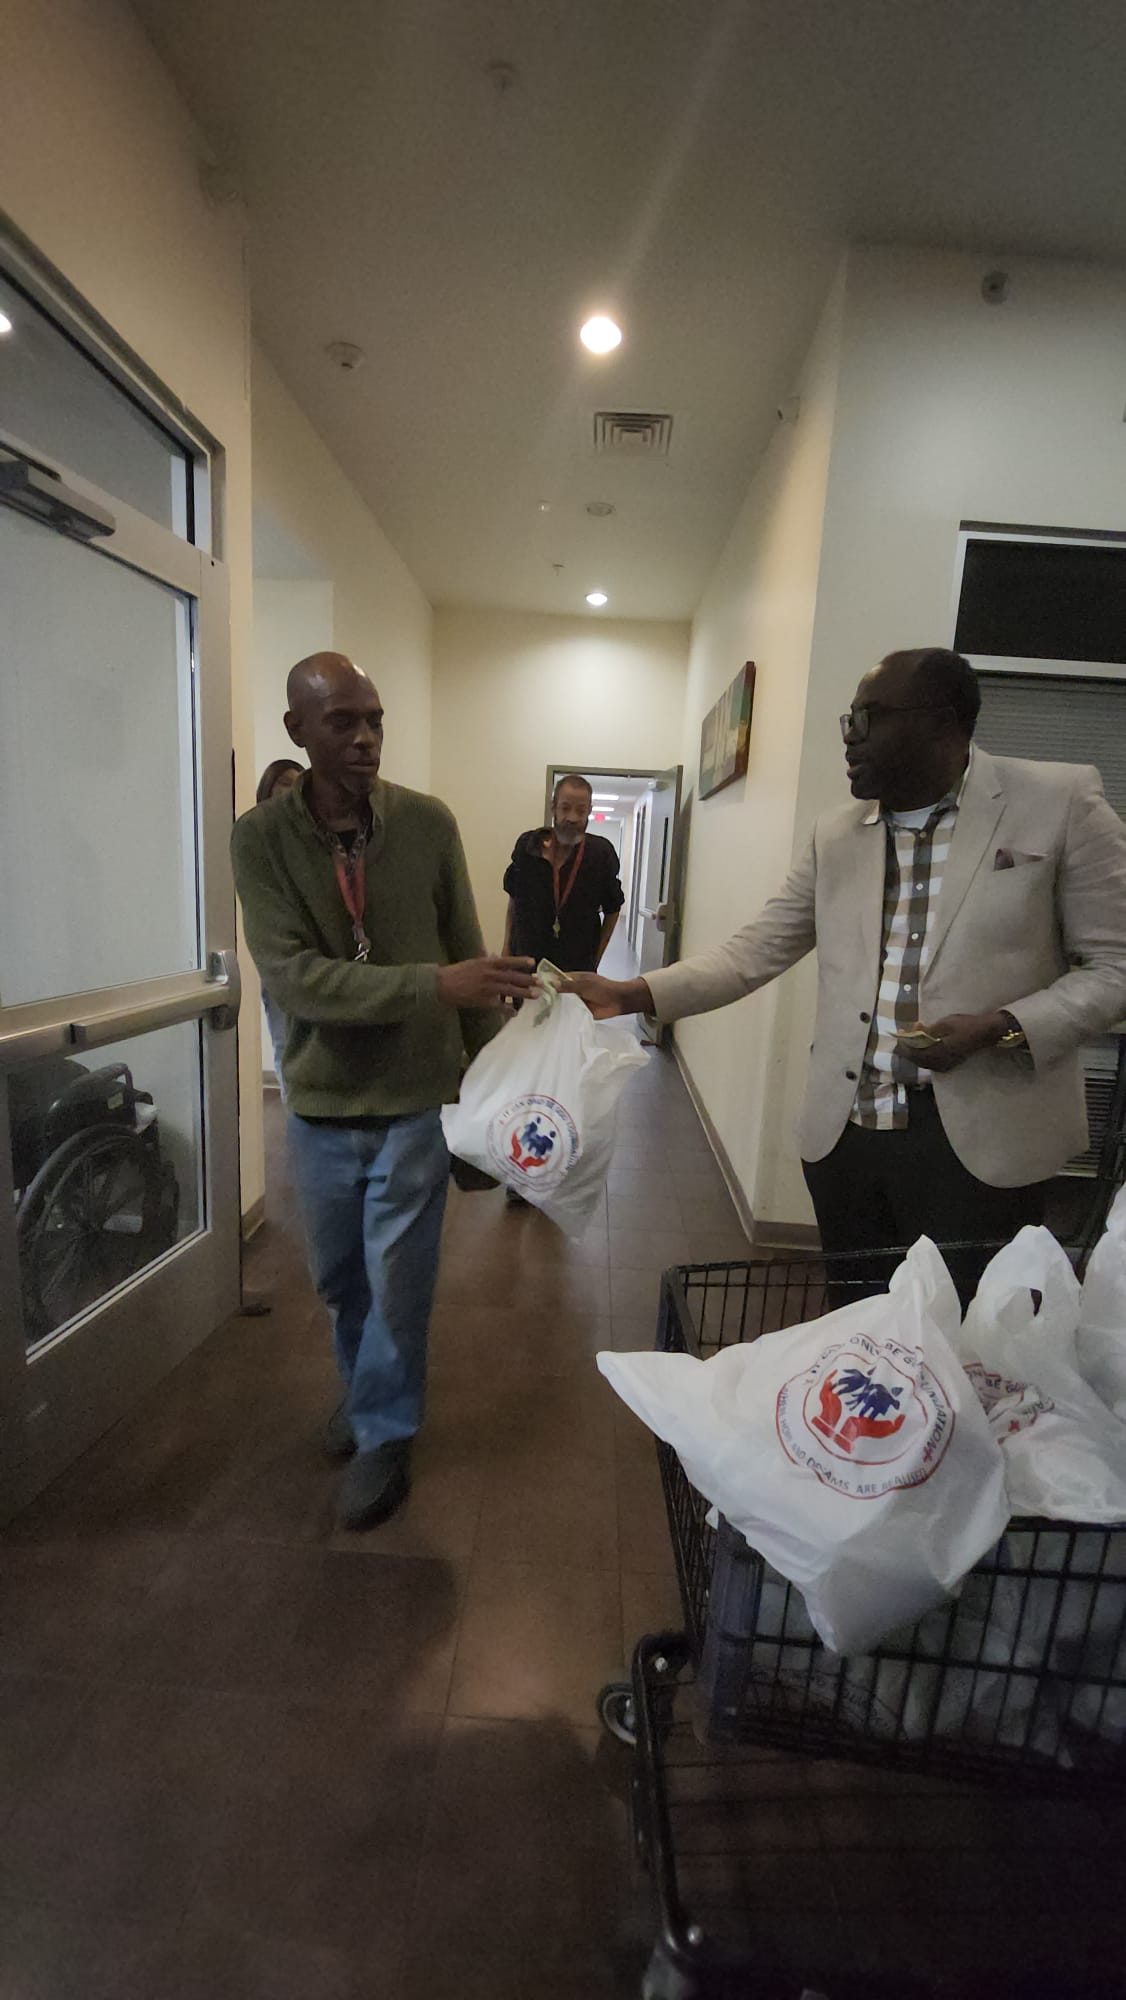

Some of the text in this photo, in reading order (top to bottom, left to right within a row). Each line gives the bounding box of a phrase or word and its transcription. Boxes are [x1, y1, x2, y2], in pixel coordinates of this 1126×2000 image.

[849, 1336, 881, 1357] ONLY
[885, 1342, 904, 1357] BE
[806, 1456, 850, 1490] DRAMS
[855, 1483, 878, 1495] ARE
